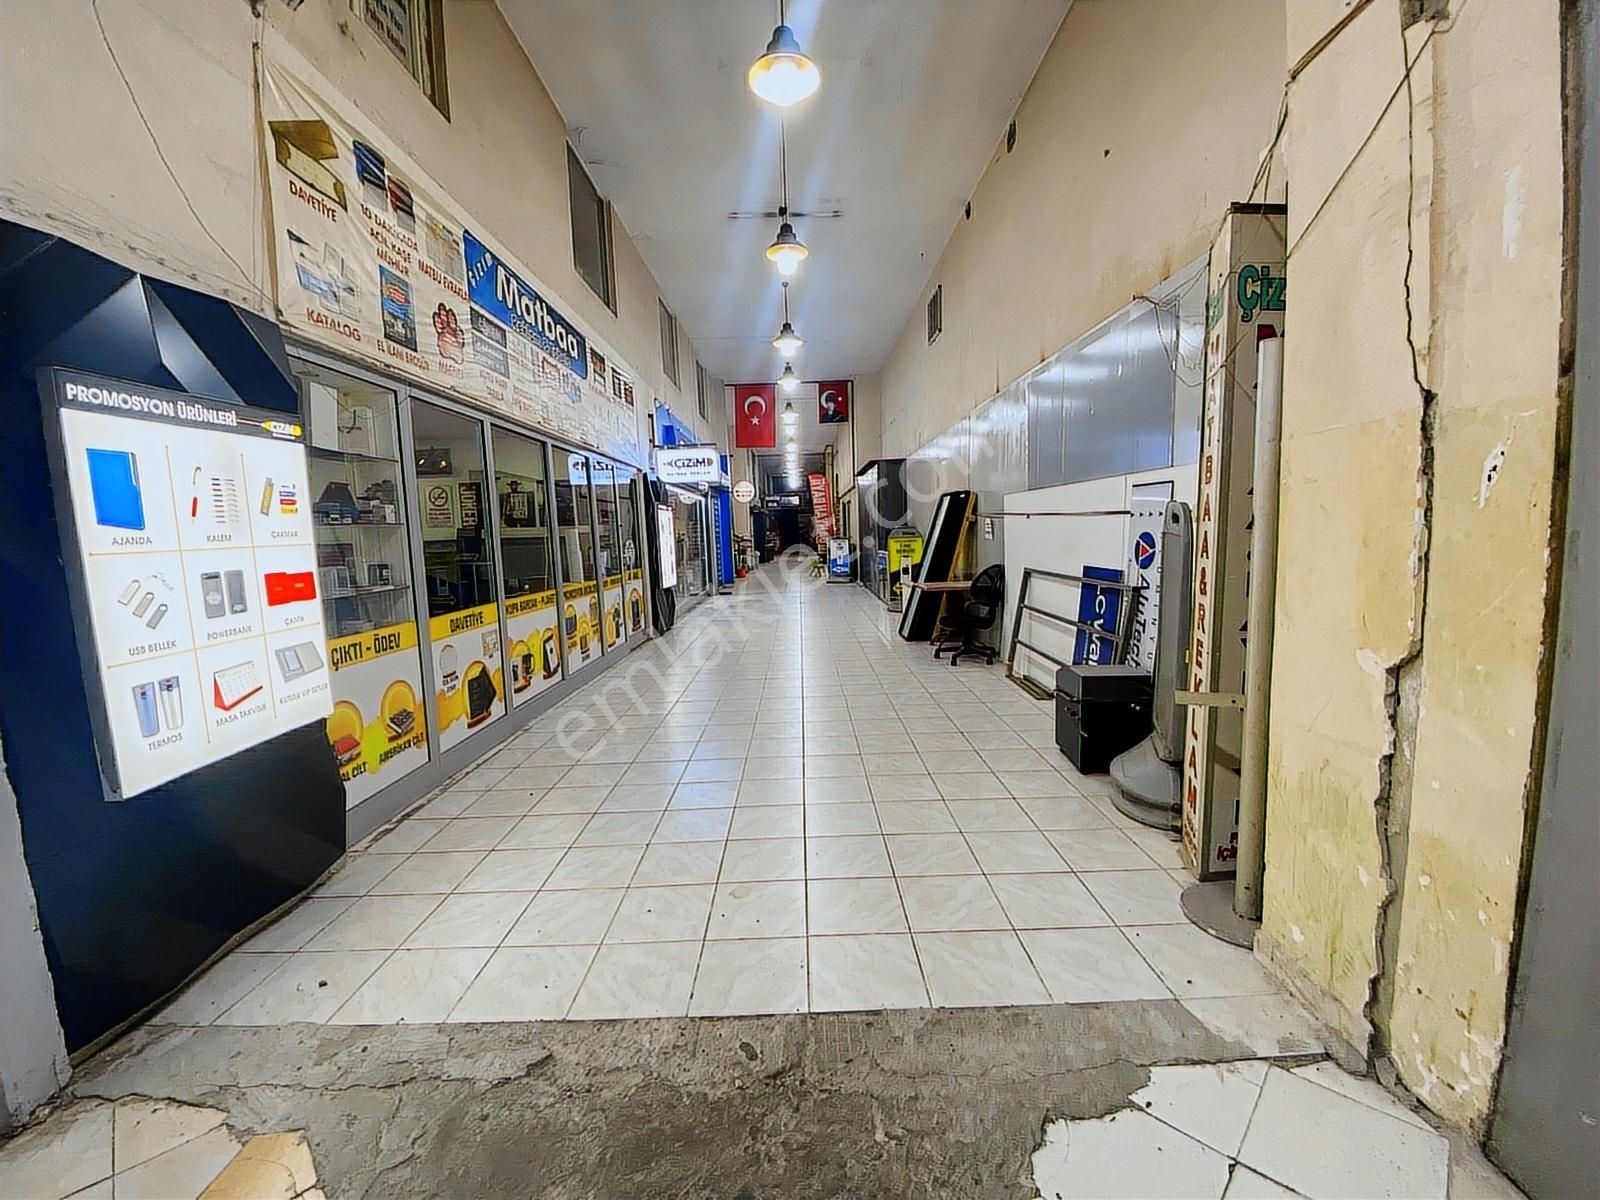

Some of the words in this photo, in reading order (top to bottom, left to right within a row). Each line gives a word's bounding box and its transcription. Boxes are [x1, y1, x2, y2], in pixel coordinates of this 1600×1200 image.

[289, 180, 337, 222] DAVETİYE
[497, 265, 578, 360] Matbaa
[307, 308, 361, 342] KATALOG
[66, 383, 176, 417] PROMOSYON
[177, 401, 238, 426] ÜRÜNLERİ
[461, 486, 478, 526] JOKER
[112, 535, 153, 546] AJANDA
[206, 534, 232, 543] KALEM
[207, 625, 252, 641] POWERBANK
[450, 611, 484, 634] DAVETİYE
[129, 645, 147, 656] USB
[148, 640, 177, 654] BELLEK
[331, 642, 363, 672] ÇIKTI
[373, 631, 401, 655] ÖDEV
[216, 713, 239, 728] MASA
[148, 732, 184, 752] TERMOS
